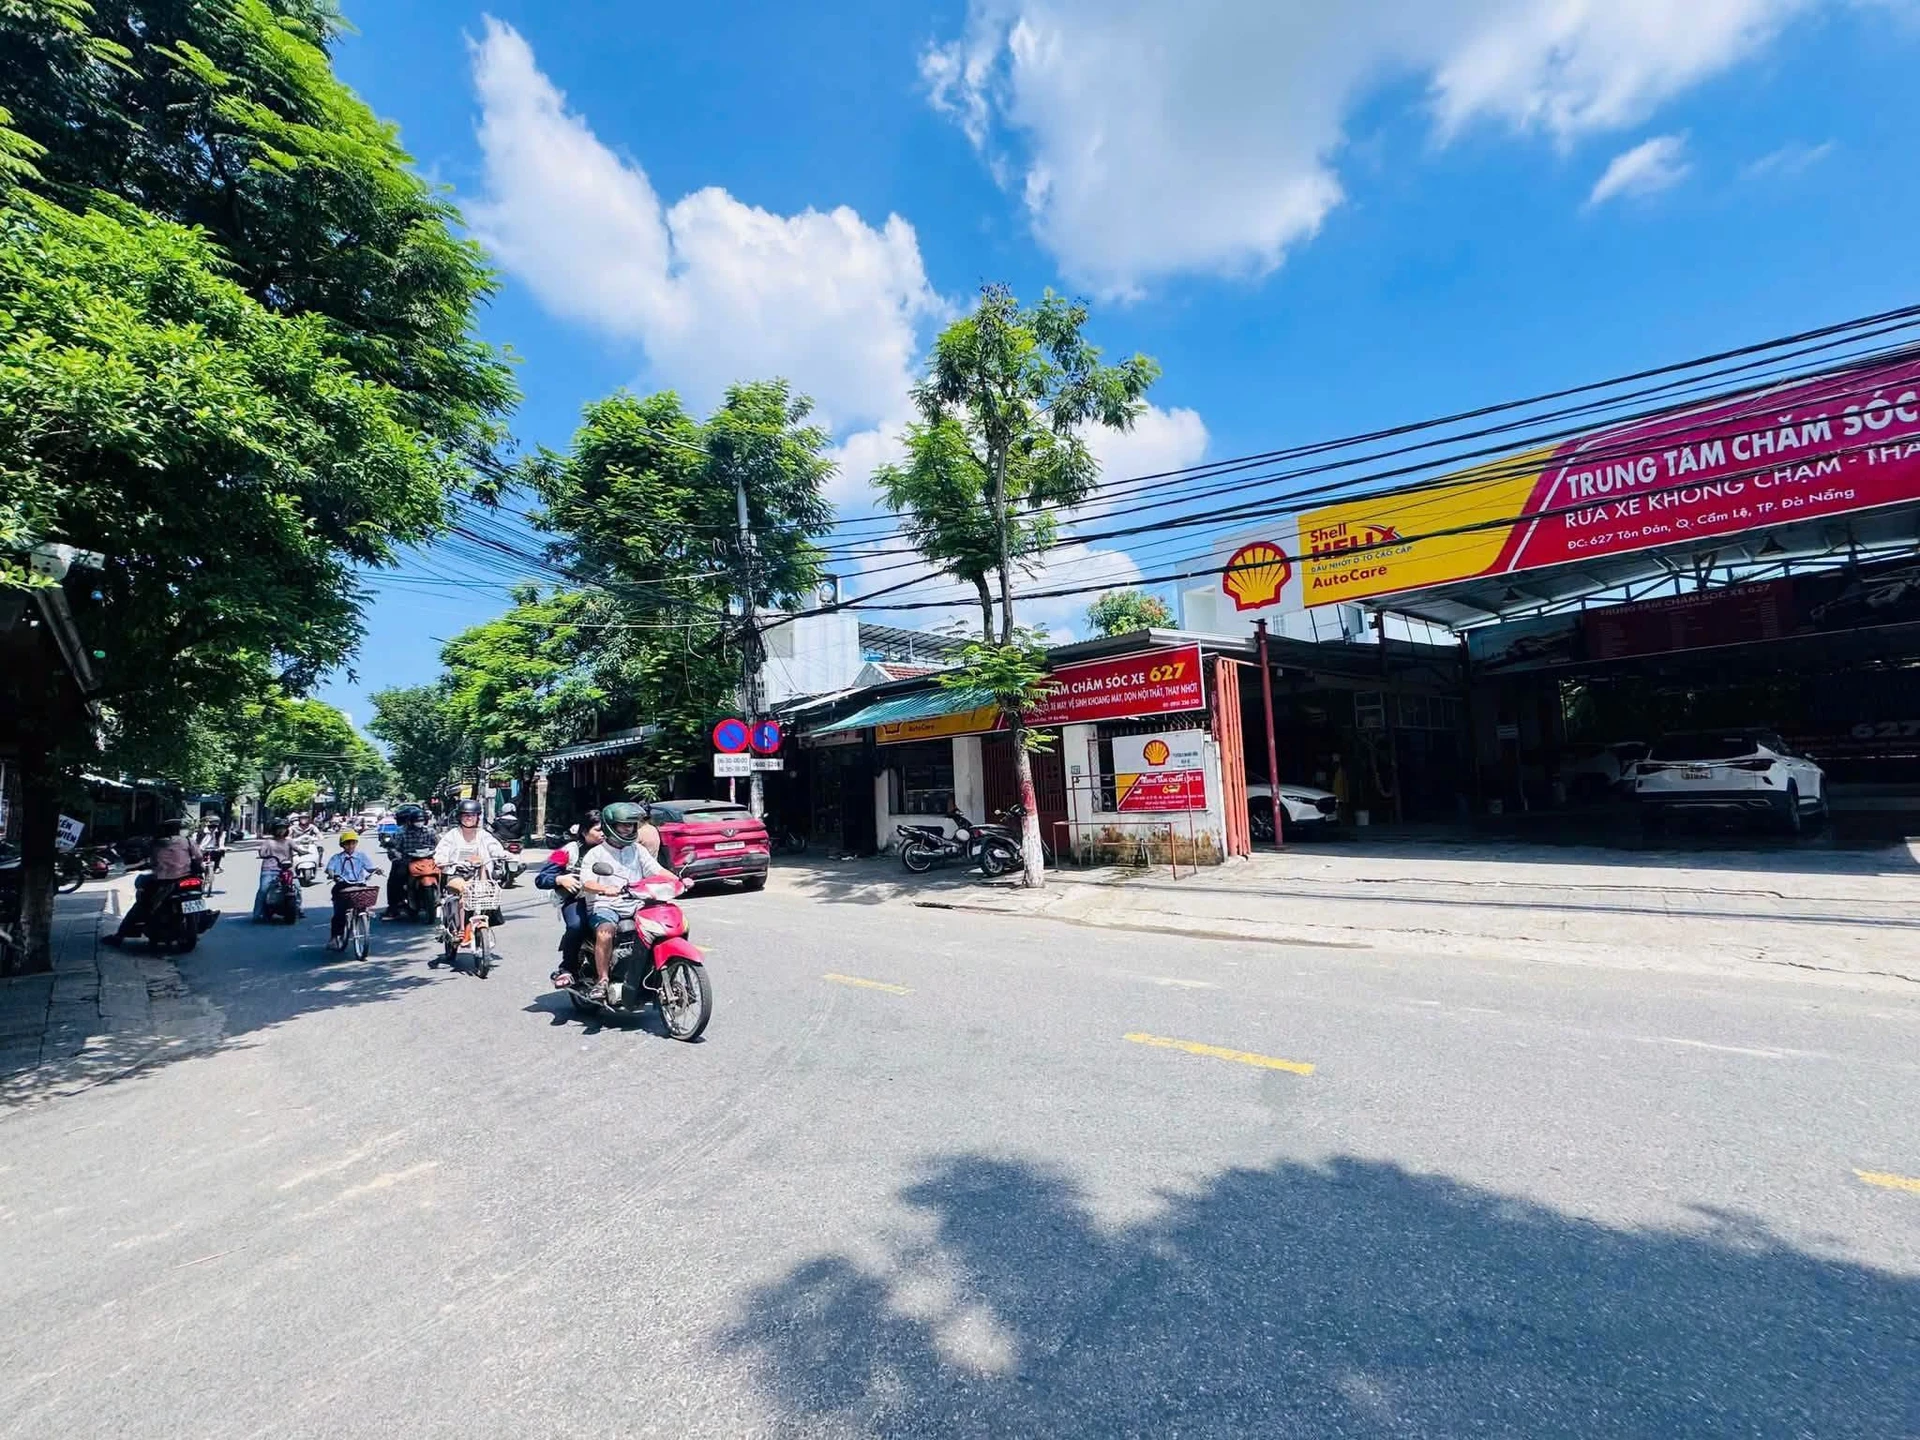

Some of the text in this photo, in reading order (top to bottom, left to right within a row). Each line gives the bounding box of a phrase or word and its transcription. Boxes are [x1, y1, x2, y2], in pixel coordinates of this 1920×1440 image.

[1566, 390, 1918, 499] TRUNG TÂM CHĂM SÓC
[1615, 498, 1641, 518] XE
[1754, 454, 1843, 489] CHẠM
[1310, 522, 1347, 544] Shell
[1590, 533, 1614, 545] 627
[1616, 529, 1639, 541] Tôn
[1782, 497, 1804, 509] Đà
[1311, 565, 1388, 590] AutoCare
[1071, 677, 1104, 694] CHĂM
[1106, 672, 1129, 689] SÓC
[1131, 671, 1146, 685] XE
[1149, 661, 1186, 683] 627
